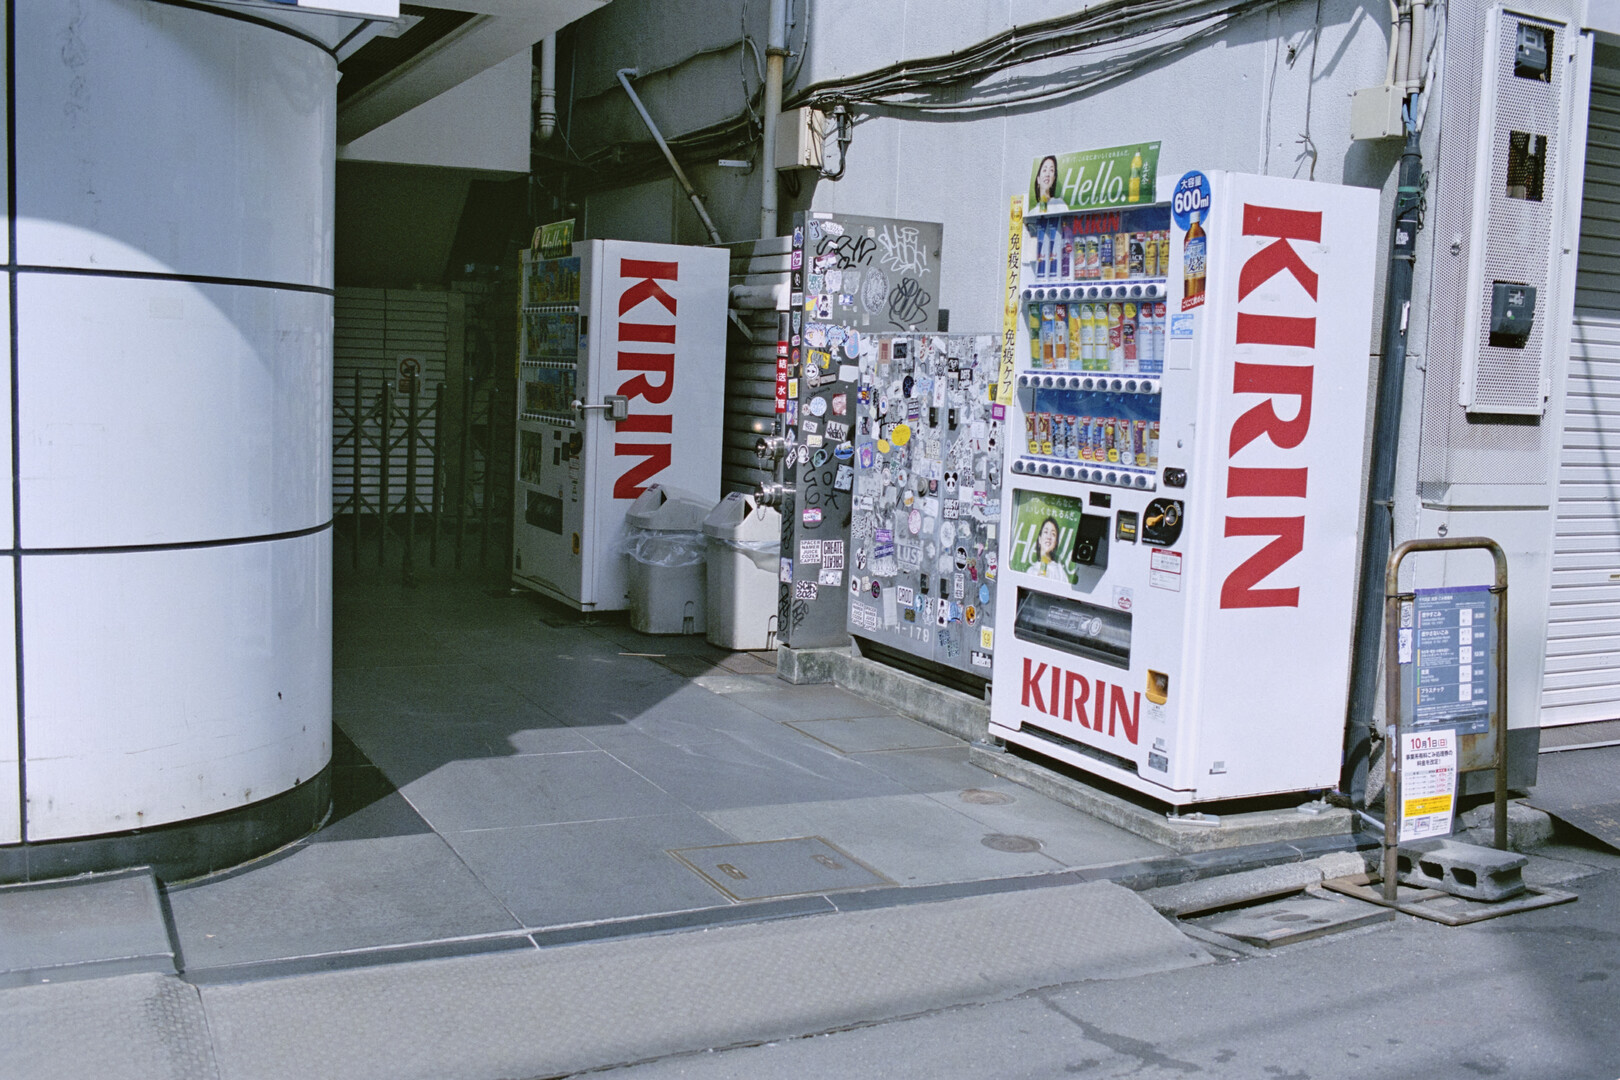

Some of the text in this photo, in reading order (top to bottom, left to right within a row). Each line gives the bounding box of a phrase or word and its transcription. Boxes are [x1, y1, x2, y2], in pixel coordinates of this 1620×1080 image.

[1061, 160, 1126, 207] Hello.
[1174, 188, 1209, 214] 600ml
[1181, 175, 1202, 189] 大容量
[1072, 211, 1120, 234] KIRIN
[1008, 233, 1020, 299] 免疫ケア
[613, 258, 679, 500] KIRIN
[1002, 328, 1015, 394] 免疫ケア
[1220, 203, 1323, 610] KIRIN
[1021, 657, 1141, 745] KIRIN
